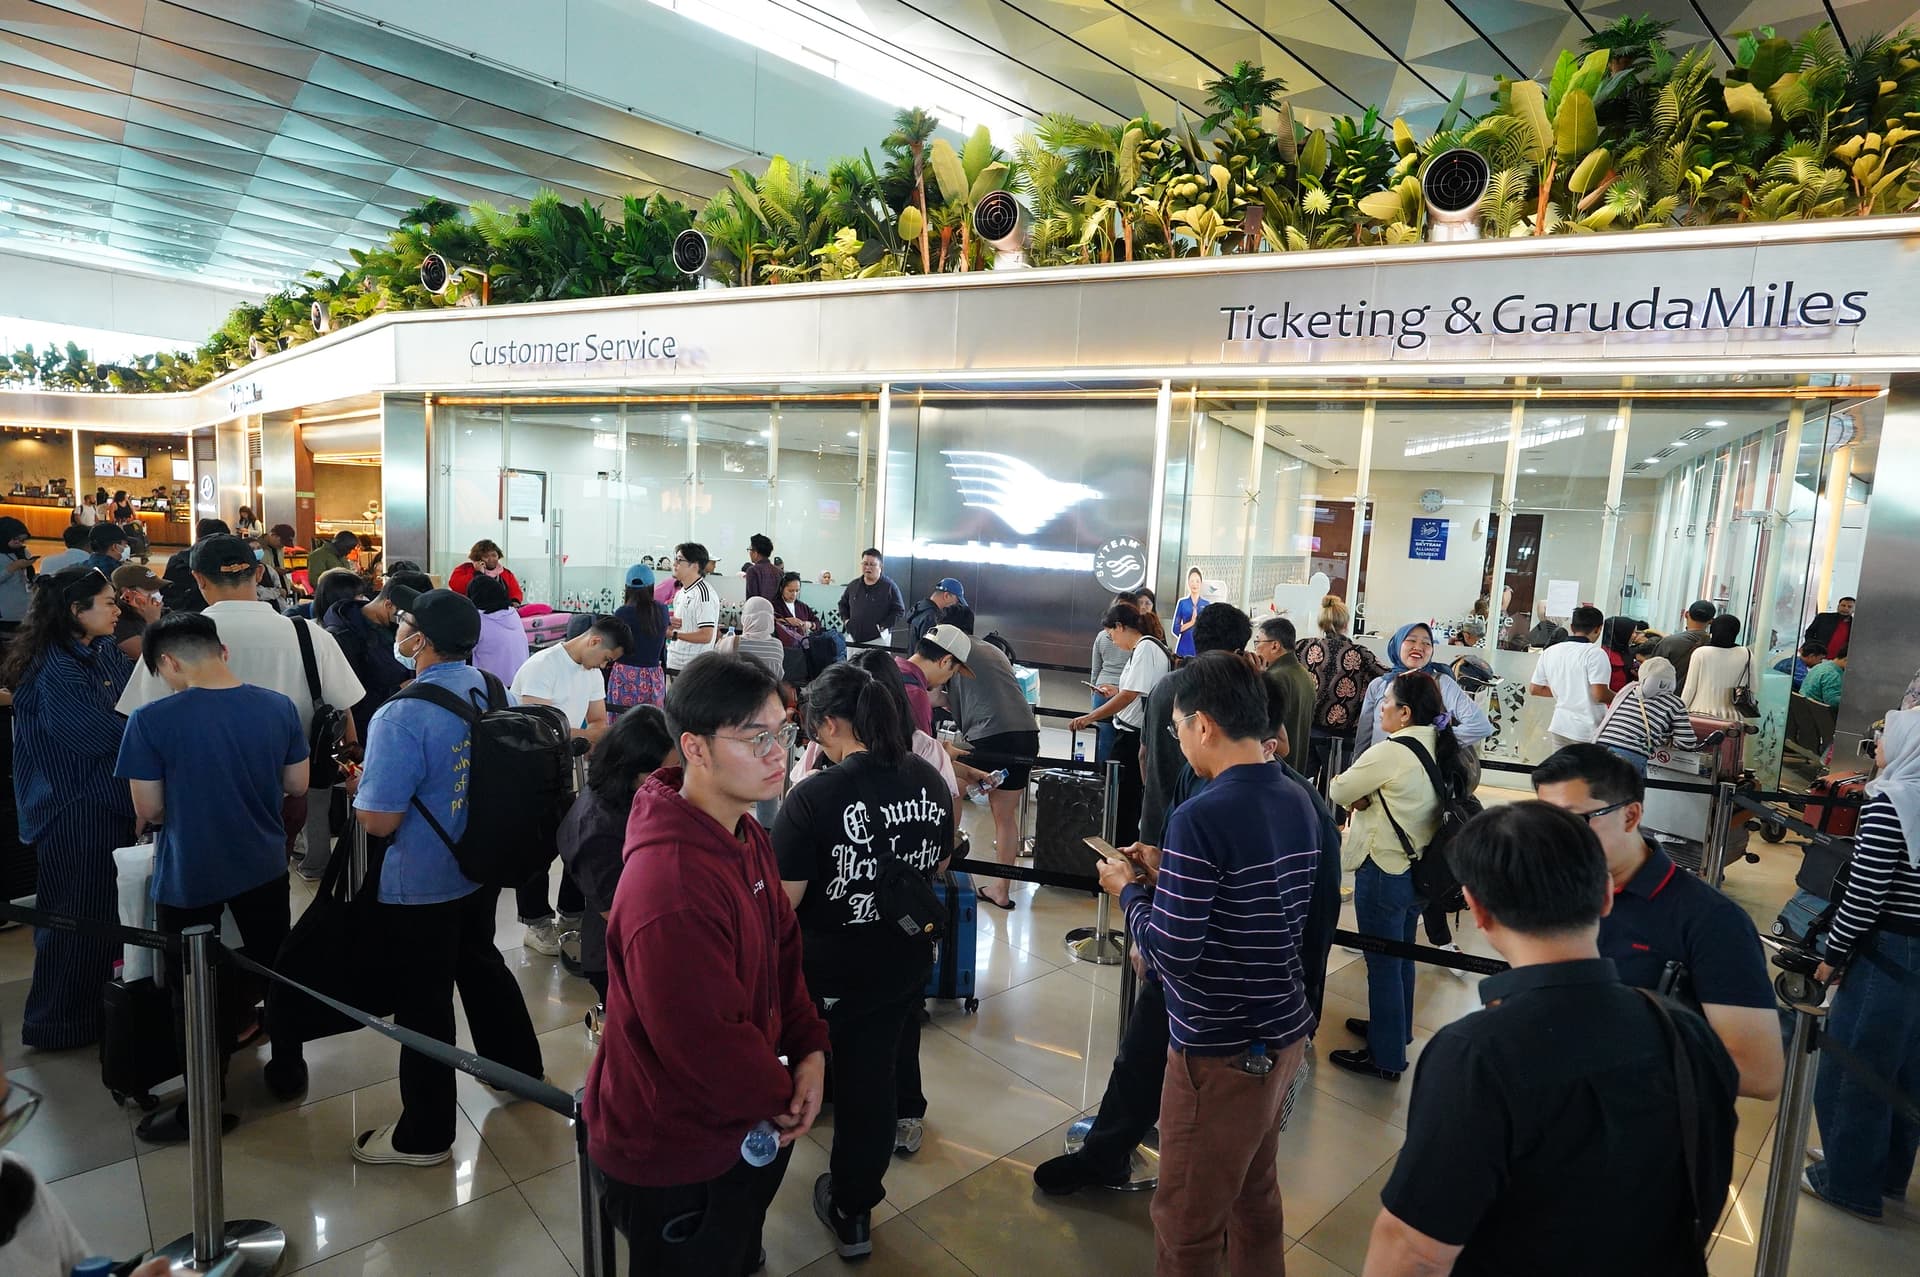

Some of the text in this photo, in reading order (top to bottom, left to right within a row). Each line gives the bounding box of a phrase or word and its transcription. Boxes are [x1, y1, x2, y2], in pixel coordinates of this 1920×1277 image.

[1219, 281, 1868, 350] Ticketing & GarudaMiles
[470, 330, 677, 366] Customer Service
[1096, 538, 1138, 578] SKYTEAM
